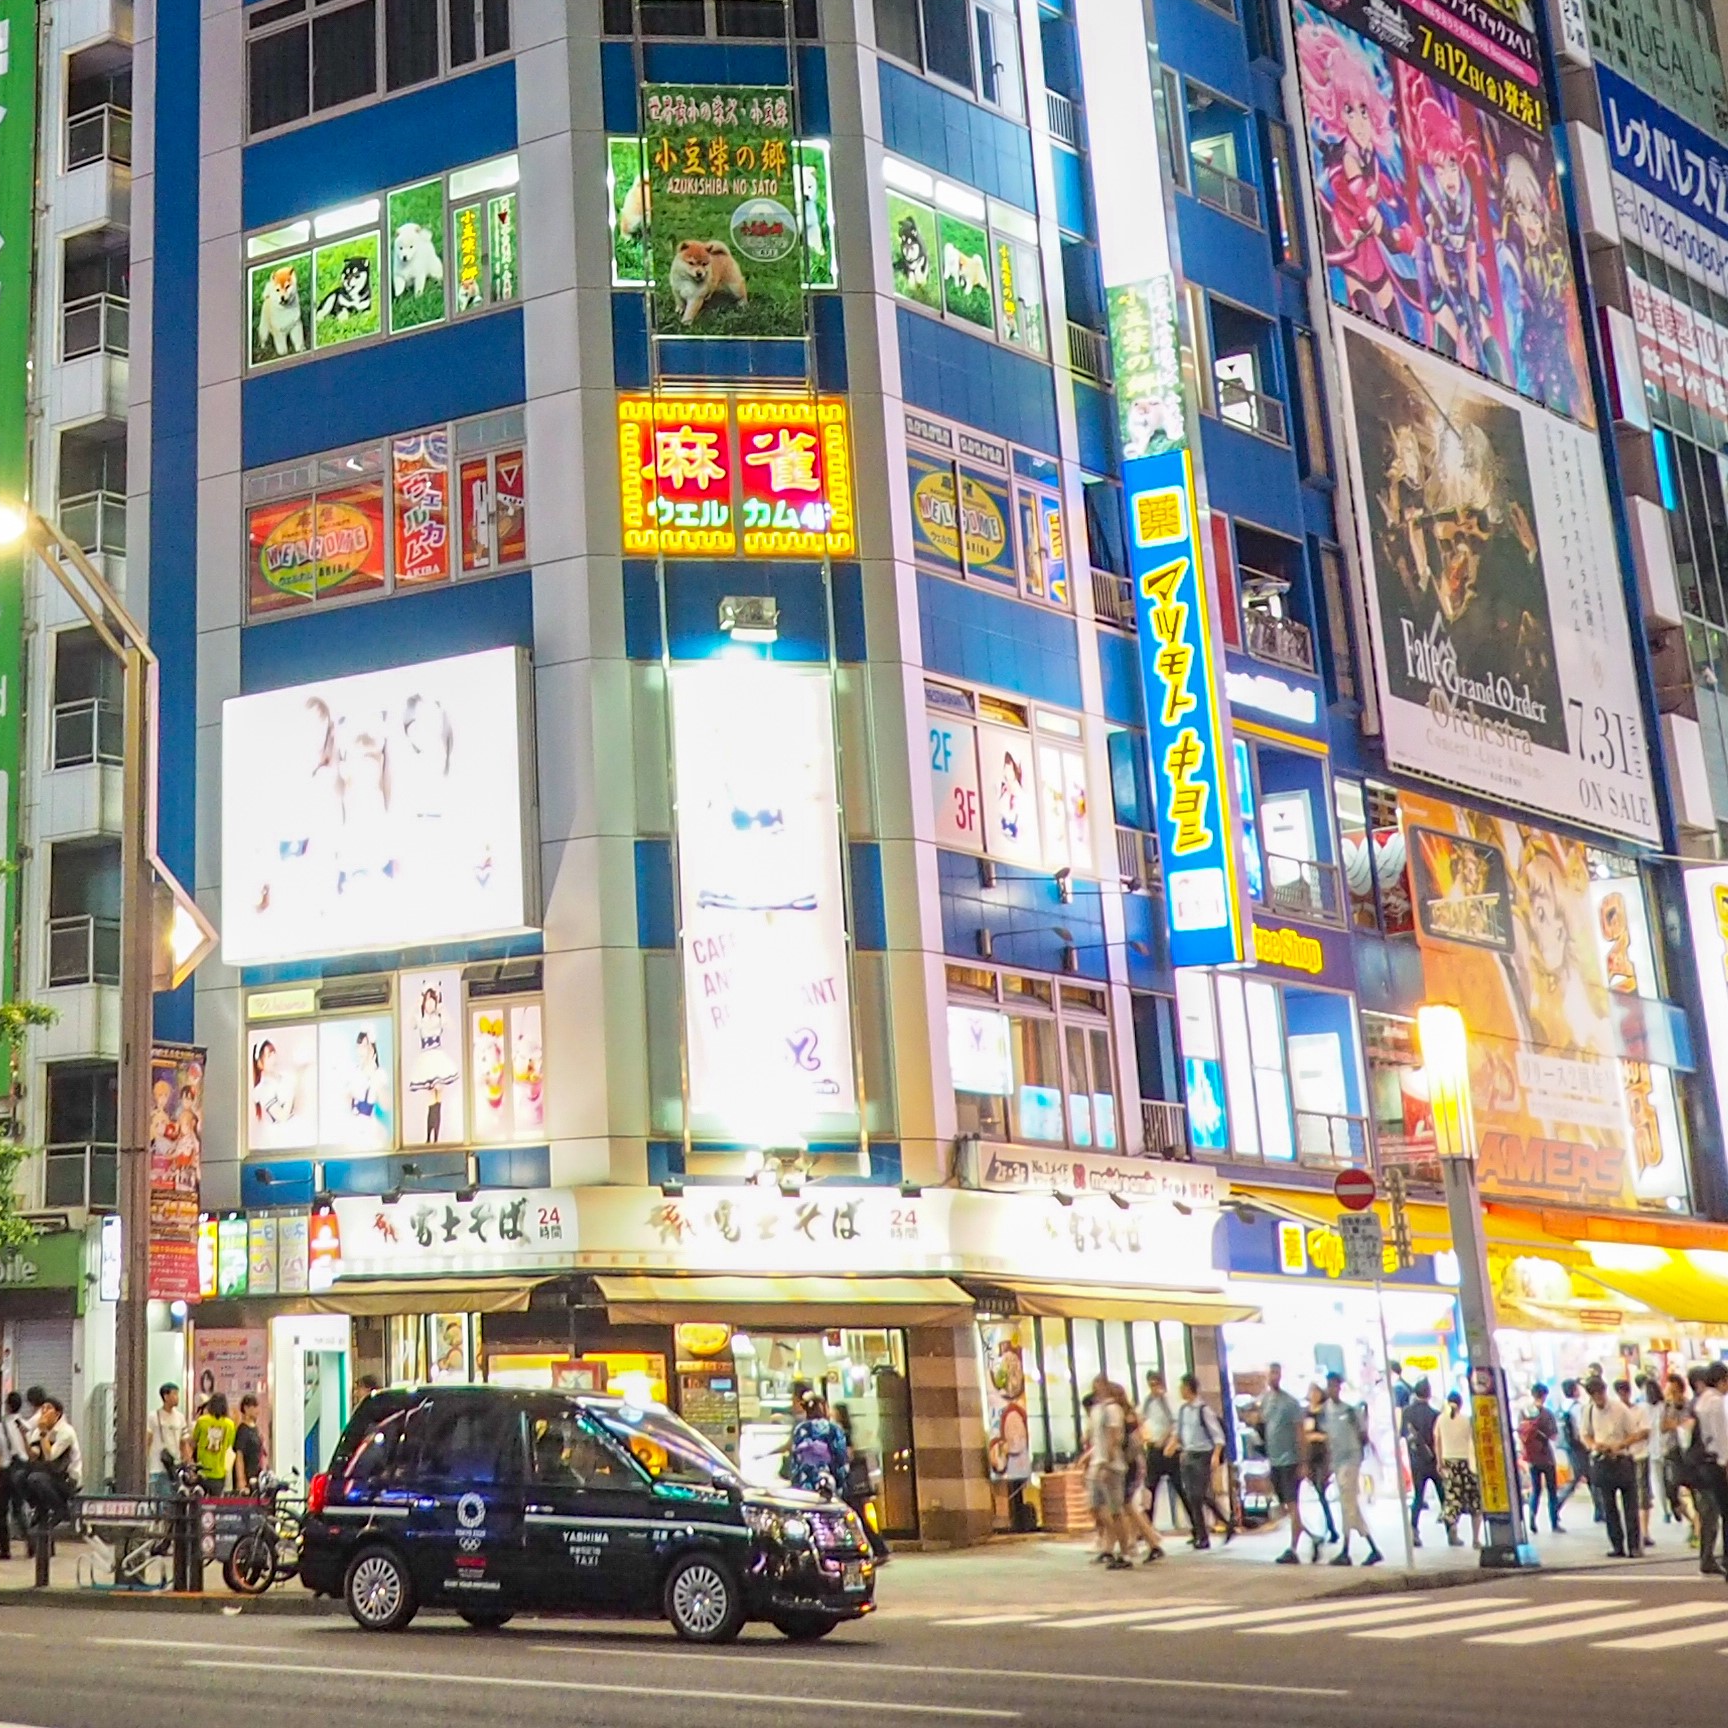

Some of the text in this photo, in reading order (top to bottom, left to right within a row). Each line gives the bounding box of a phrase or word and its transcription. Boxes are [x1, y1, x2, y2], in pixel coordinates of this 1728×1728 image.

[654, 135, 786, 178] 小豆柴の郷
[667, 177, 778, 197] AZUKISHIBA NO SATO
[640, 424, 822, 493] 麻雀
[917, 492, 1003, 544] WELCOME
[1138, 494, 1183, 540] 薬
[264, 524, 369, 571] WELCOME
[405, 564, 441, 580] AKIBA
[1141, 556, 1213, 855] マツモトキヨシ
[1426, 687, 1534, 757] Orchestra
[1496, 676, 1548, 724] Order
[929, 728, 953, 773] 2F
[1568, 697, 1631, 777] 7.31
[953, 786, 976, 832] 3F
[1579, 777, 1652, 827] ON SALE
[692, 932, 736, 965] CAF
[1279, 926, 1324, 975] Shop
[1476, 1129, 1626, 1195] AMERS
[537, 1206, 562, 1226] 24
[538, 1224, 563, 1241] 時間
[889, 1208, 918, 1226] 24
[562, 1530, 610, 1544] YASHIMA
[574, 1555, 599, 1567] TAXI
